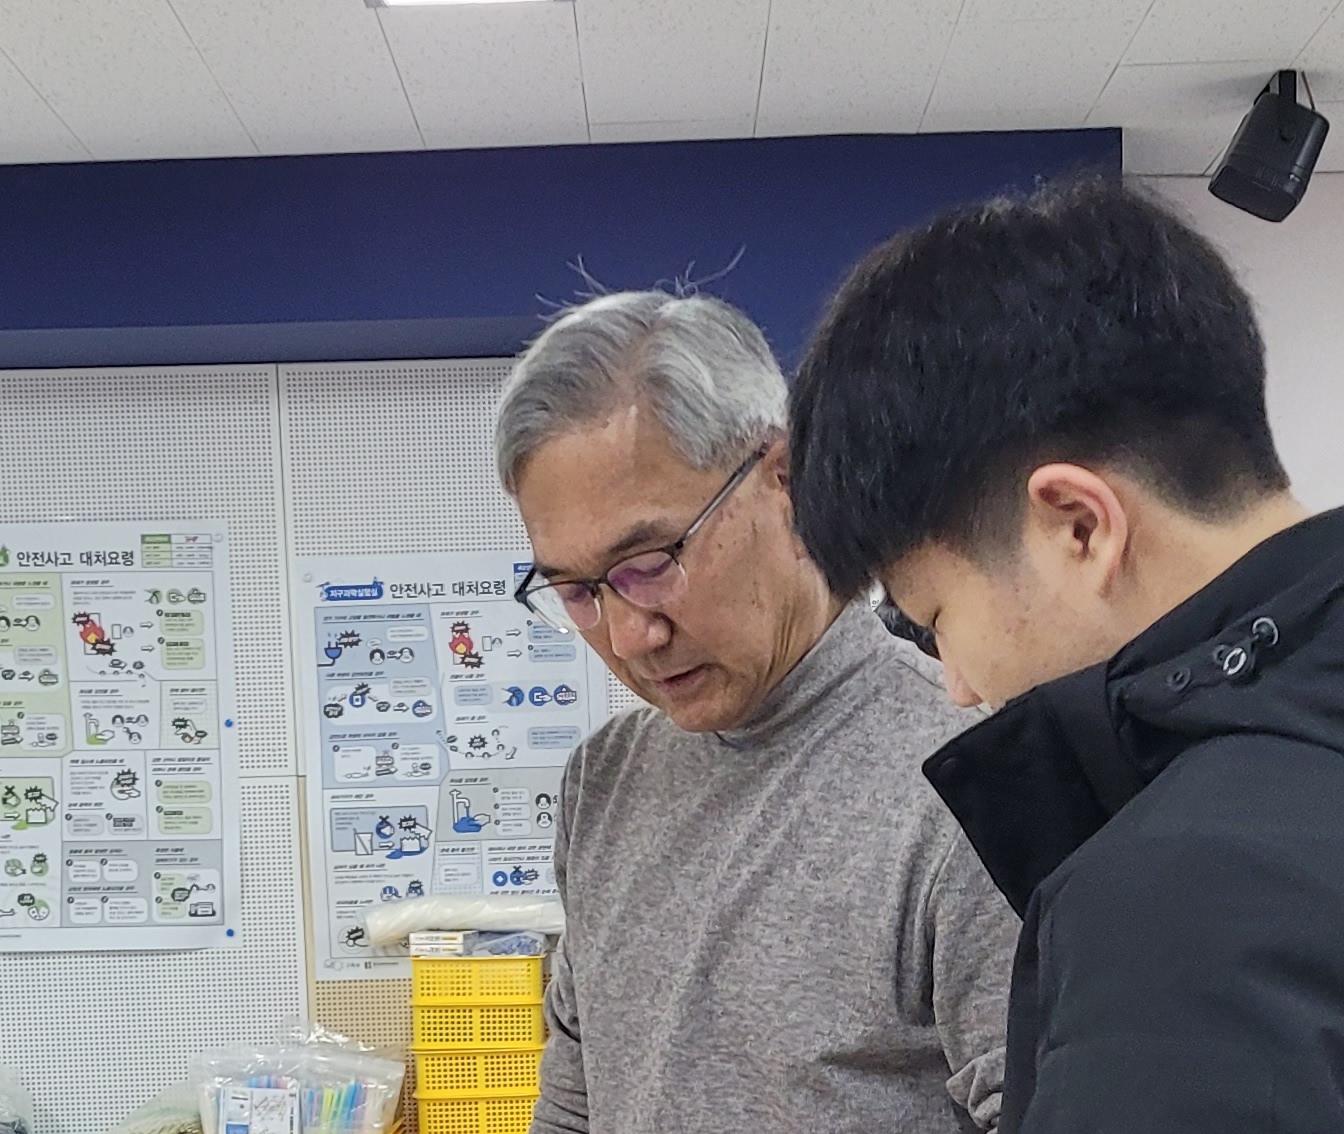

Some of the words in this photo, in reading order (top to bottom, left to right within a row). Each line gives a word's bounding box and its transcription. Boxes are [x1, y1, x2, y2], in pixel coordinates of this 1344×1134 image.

[17, 550, 74, 568] 안전사고
[80, 550, 134, 567] 대처요령
[389, 582, 446, 599] 안전사고
[452, 580, 506, 597] 대처요령
